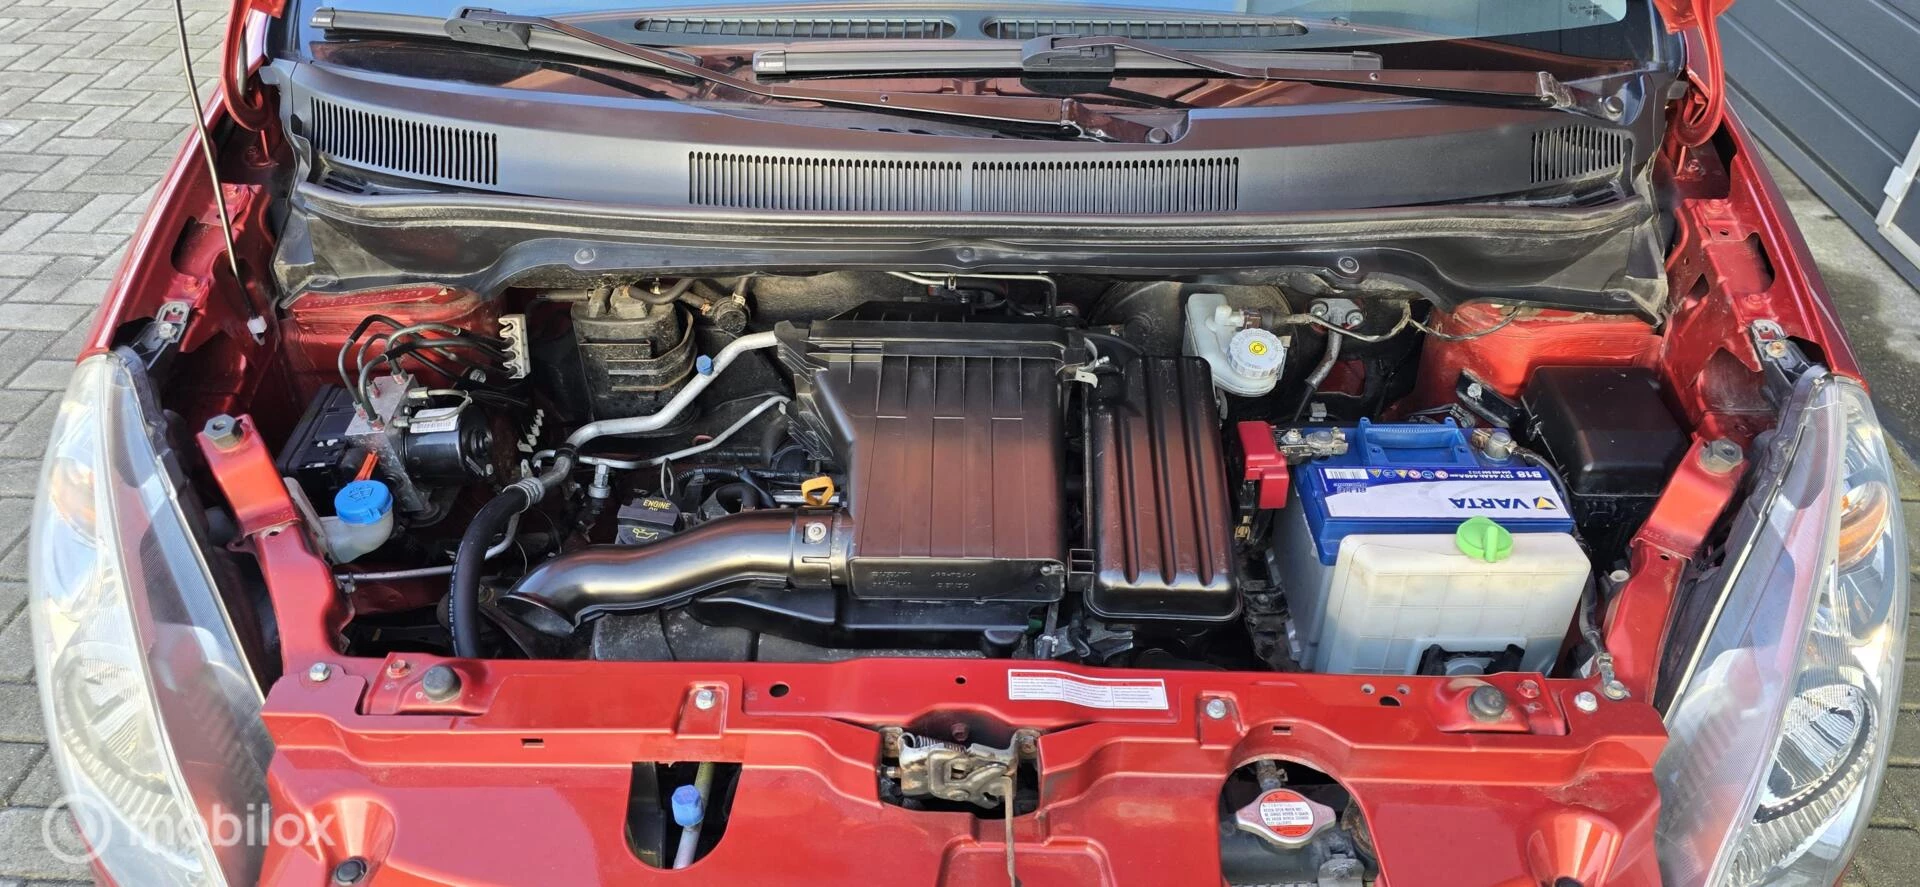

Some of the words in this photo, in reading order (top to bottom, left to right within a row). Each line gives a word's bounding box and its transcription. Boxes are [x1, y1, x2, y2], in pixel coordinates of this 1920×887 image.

[1516, 470, 1543, 478] B18
[643, 499, 671, 510] ENGINE
[1448, 498, 1530, 509] VARTA
